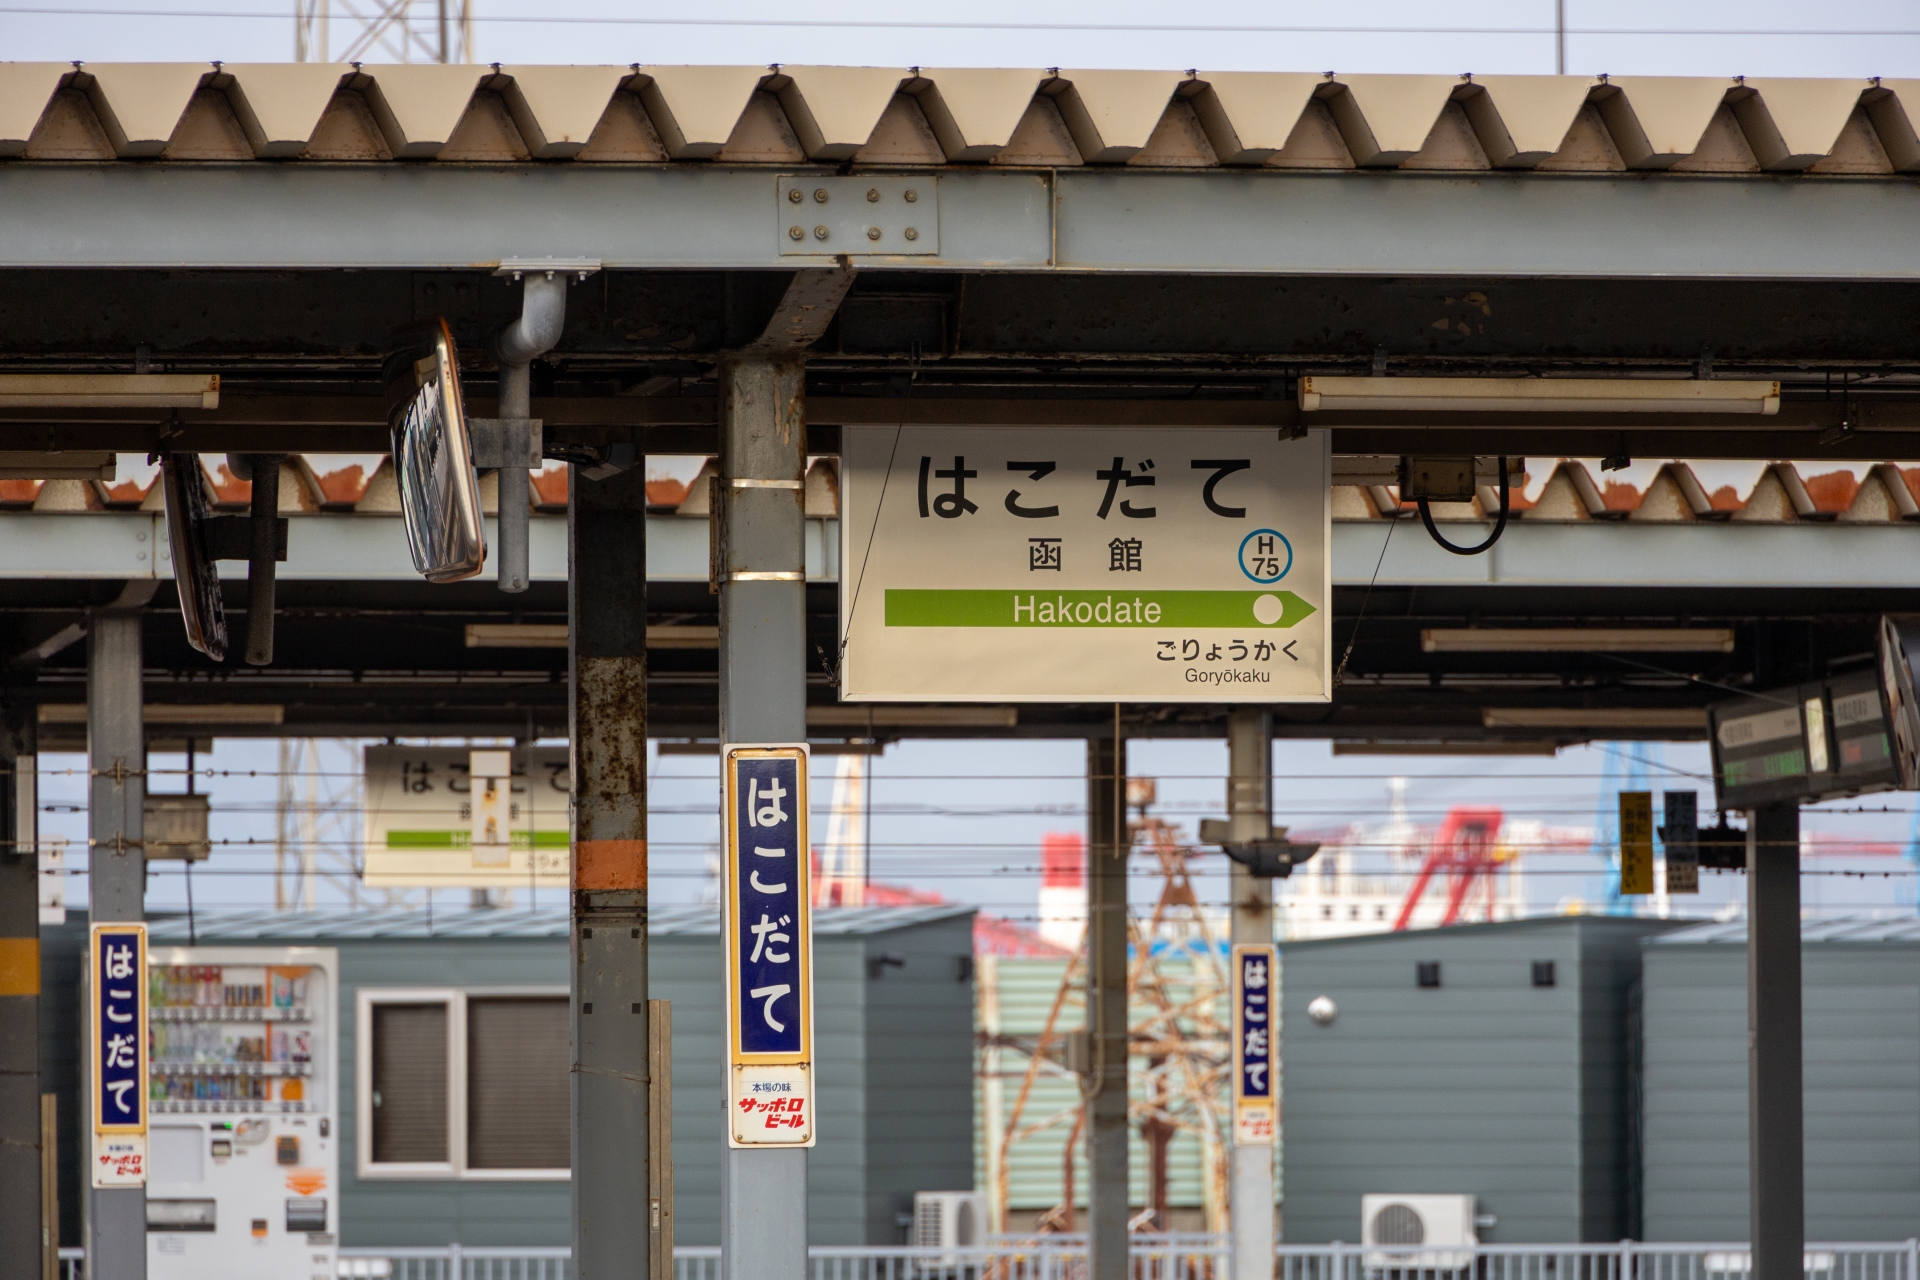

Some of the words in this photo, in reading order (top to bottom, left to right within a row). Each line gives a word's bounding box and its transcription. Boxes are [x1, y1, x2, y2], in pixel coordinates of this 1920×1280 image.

[918, 455, 1251, 520] はこだて
[1028, 537, 1143, 572] 函館
[1257, 536, 1275, 555] H
[1251, 557, 1280, 577] 75
[1013, 595, 1162, 624] Hakodate
[1156, 638, 1300, 662] ごりょうかく
[1185, 667, 1271, 685] Goryōkaku
[747, 777, 792, 1034] はこだて
[105, 944, 135, 1115] はこだて
[1244, 960, 1268, 1091] はこだて
[752, 1082, 792, 1093] 本場の味
[738, 1097, 805, 1113] サッポロ
[765, 1114, 805, 1129] ビール
